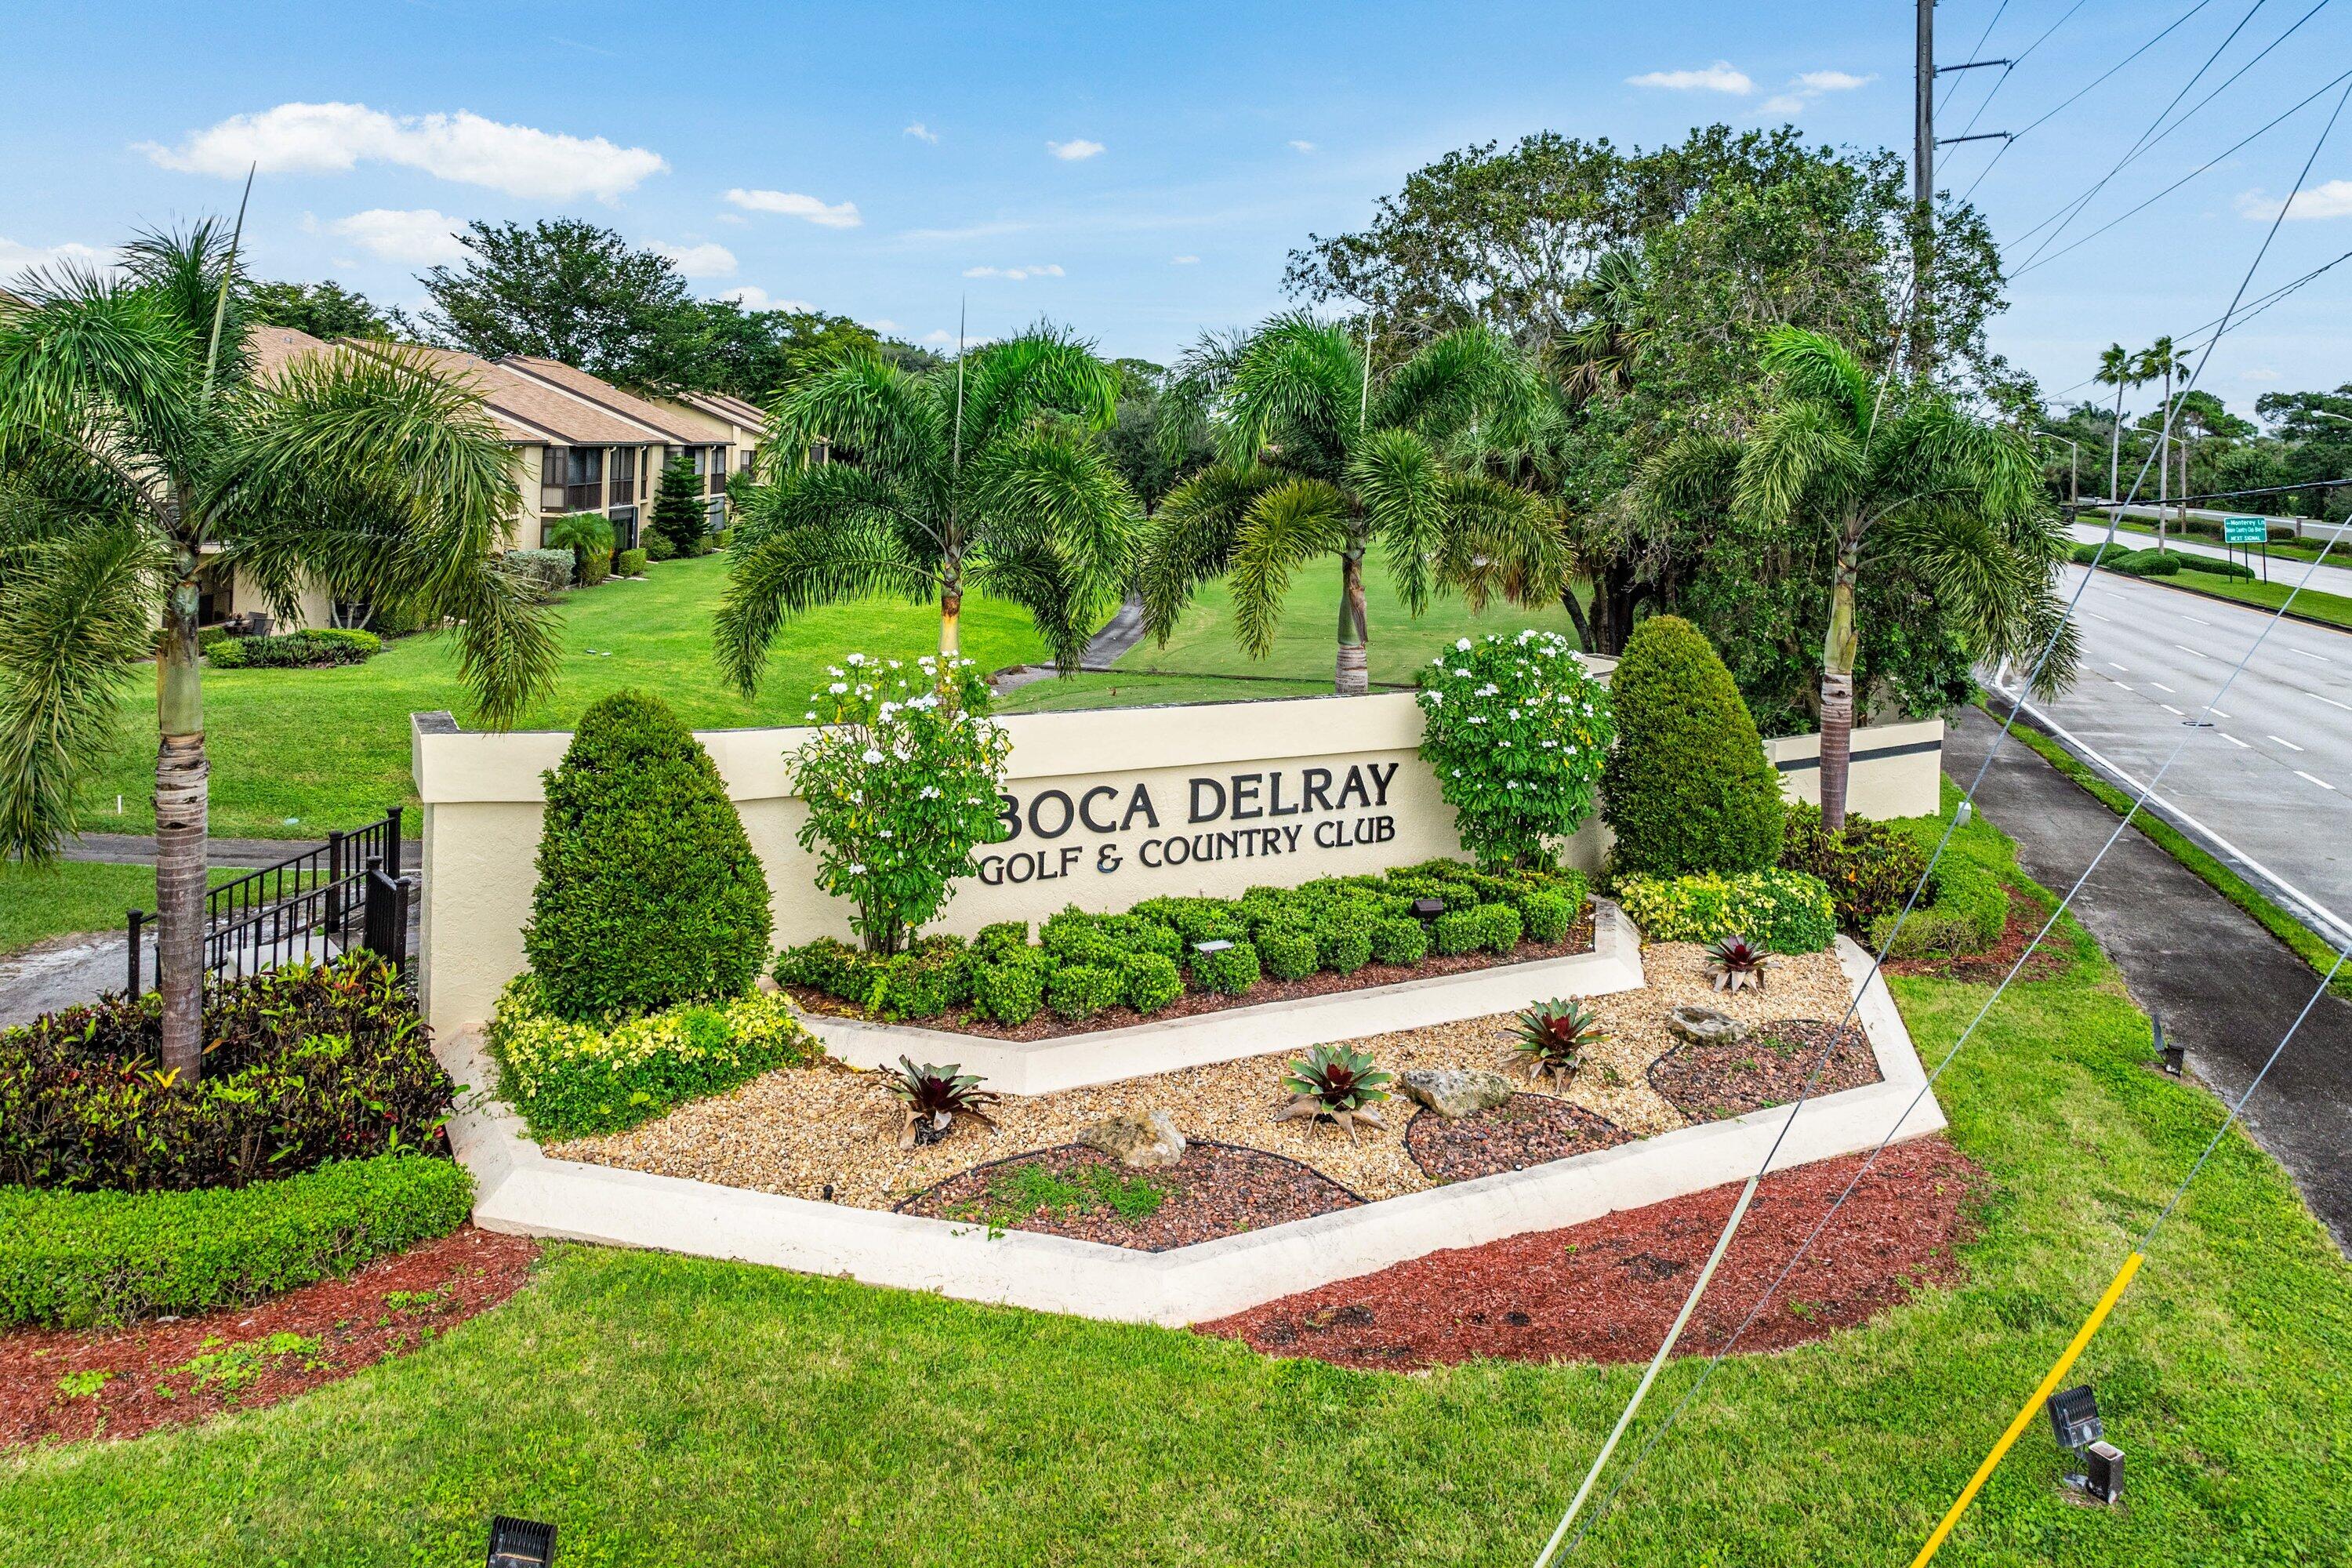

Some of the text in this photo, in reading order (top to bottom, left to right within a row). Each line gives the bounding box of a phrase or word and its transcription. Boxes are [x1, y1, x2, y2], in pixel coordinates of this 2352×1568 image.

[982, 762, 1399, 844] BOCA DELRAY
[978, 815, 1396, 886] GOLF & COUNTRY CLUB
